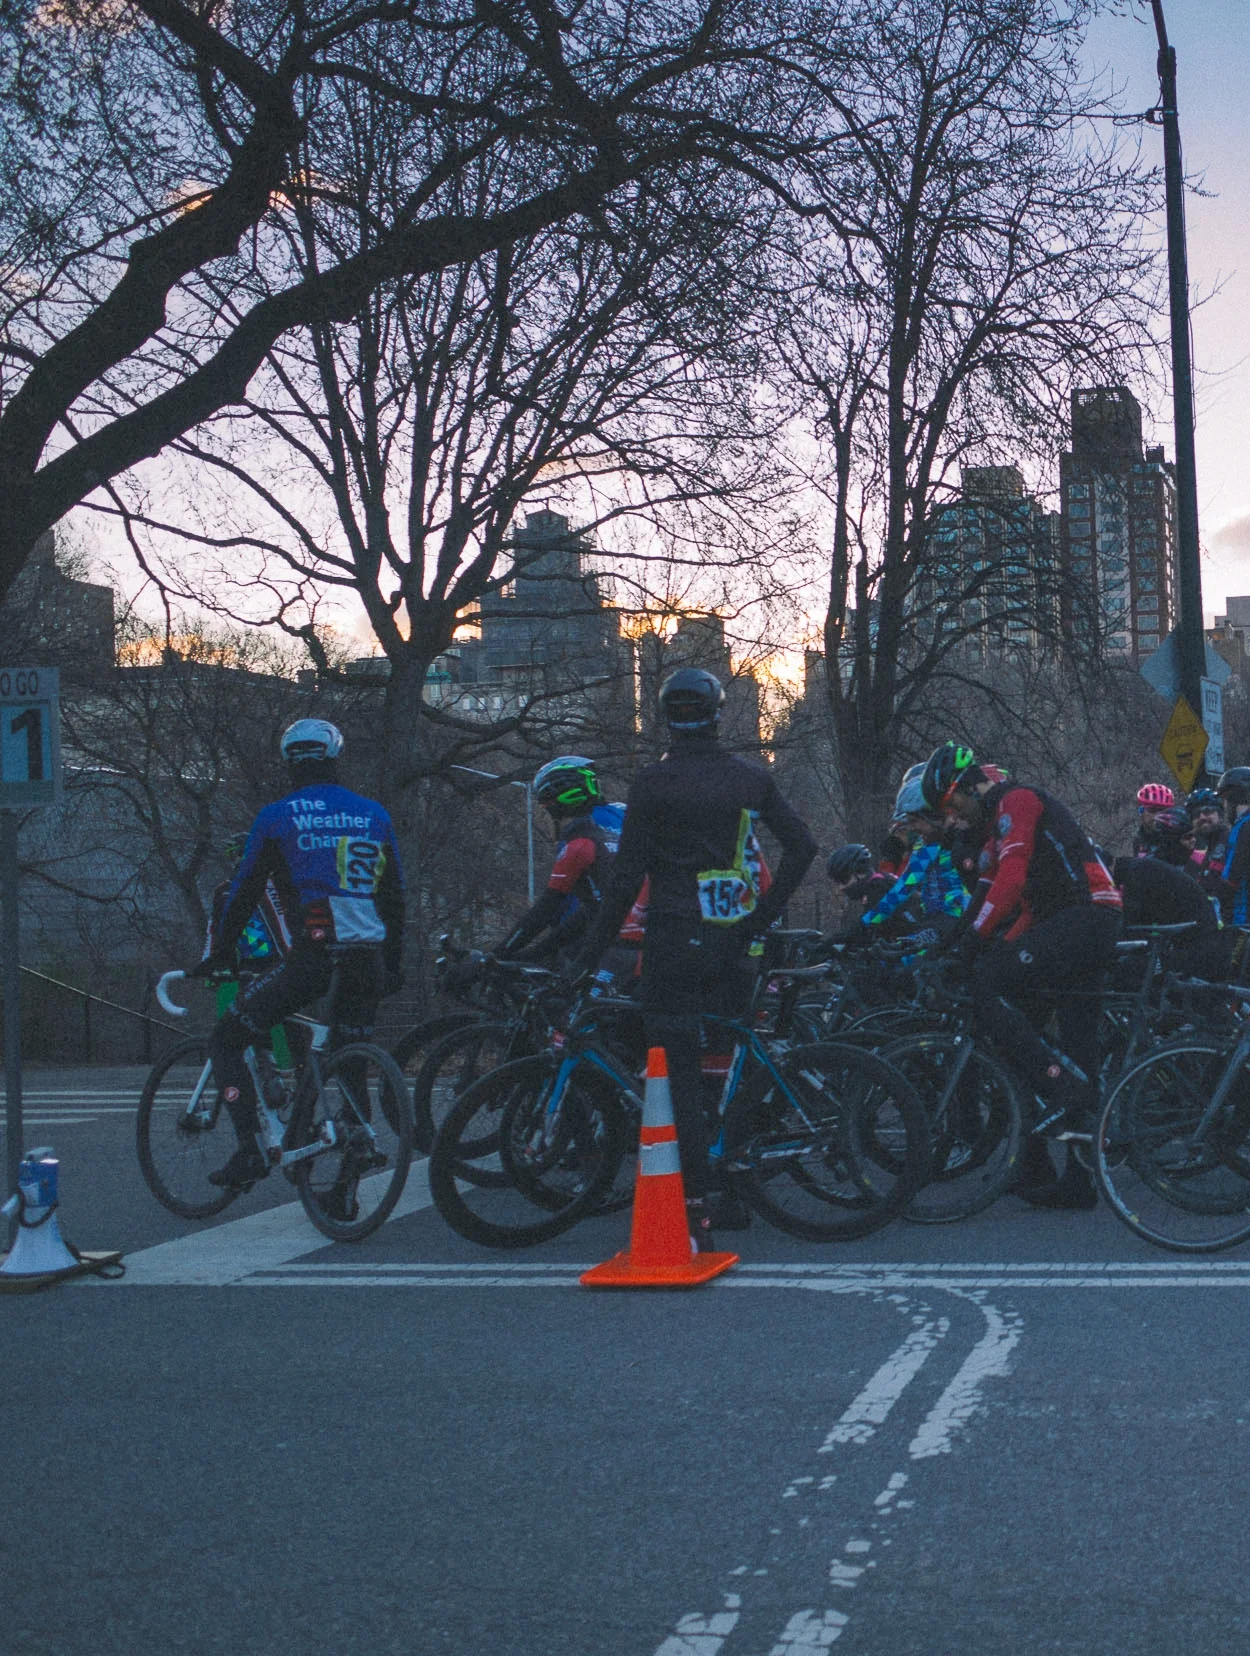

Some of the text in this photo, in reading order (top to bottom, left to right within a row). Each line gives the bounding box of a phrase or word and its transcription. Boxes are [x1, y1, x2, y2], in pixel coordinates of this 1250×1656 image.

[16, 671, 39, 696] GO
[11, 708, 43, 780] 1
[287, 798, 327, 813] The
[292, 812, 371, 831] Weather
[346, 841, 380, 889] 120
